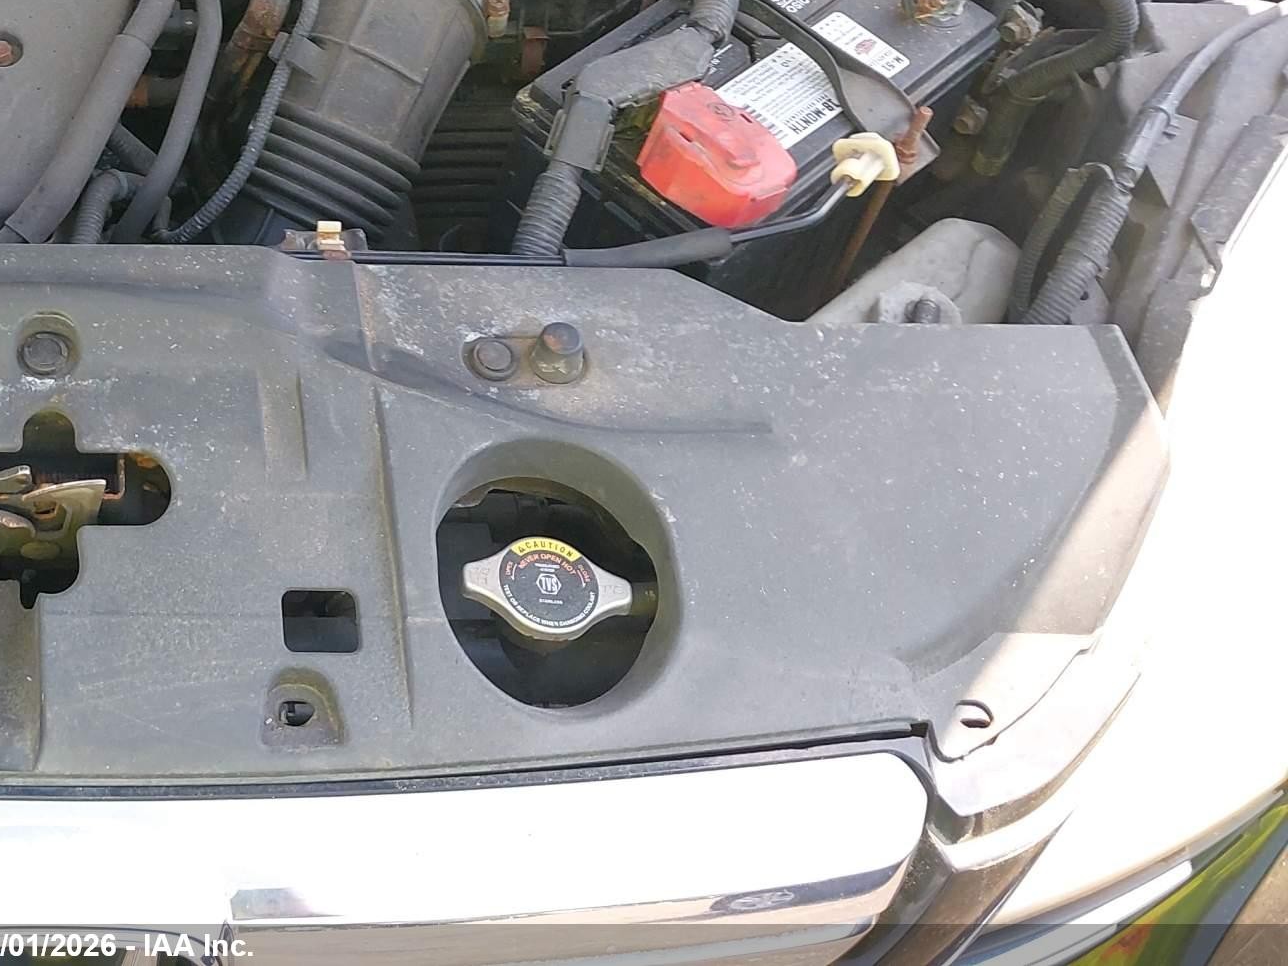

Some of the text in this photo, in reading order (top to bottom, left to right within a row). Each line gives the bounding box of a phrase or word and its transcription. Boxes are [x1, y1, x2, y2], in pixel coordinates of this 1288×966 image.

[525, 541, 574, 557] CAUTION
[540, 553, 562, 564] OPEN
[562, 560, 577, 575] HOT
